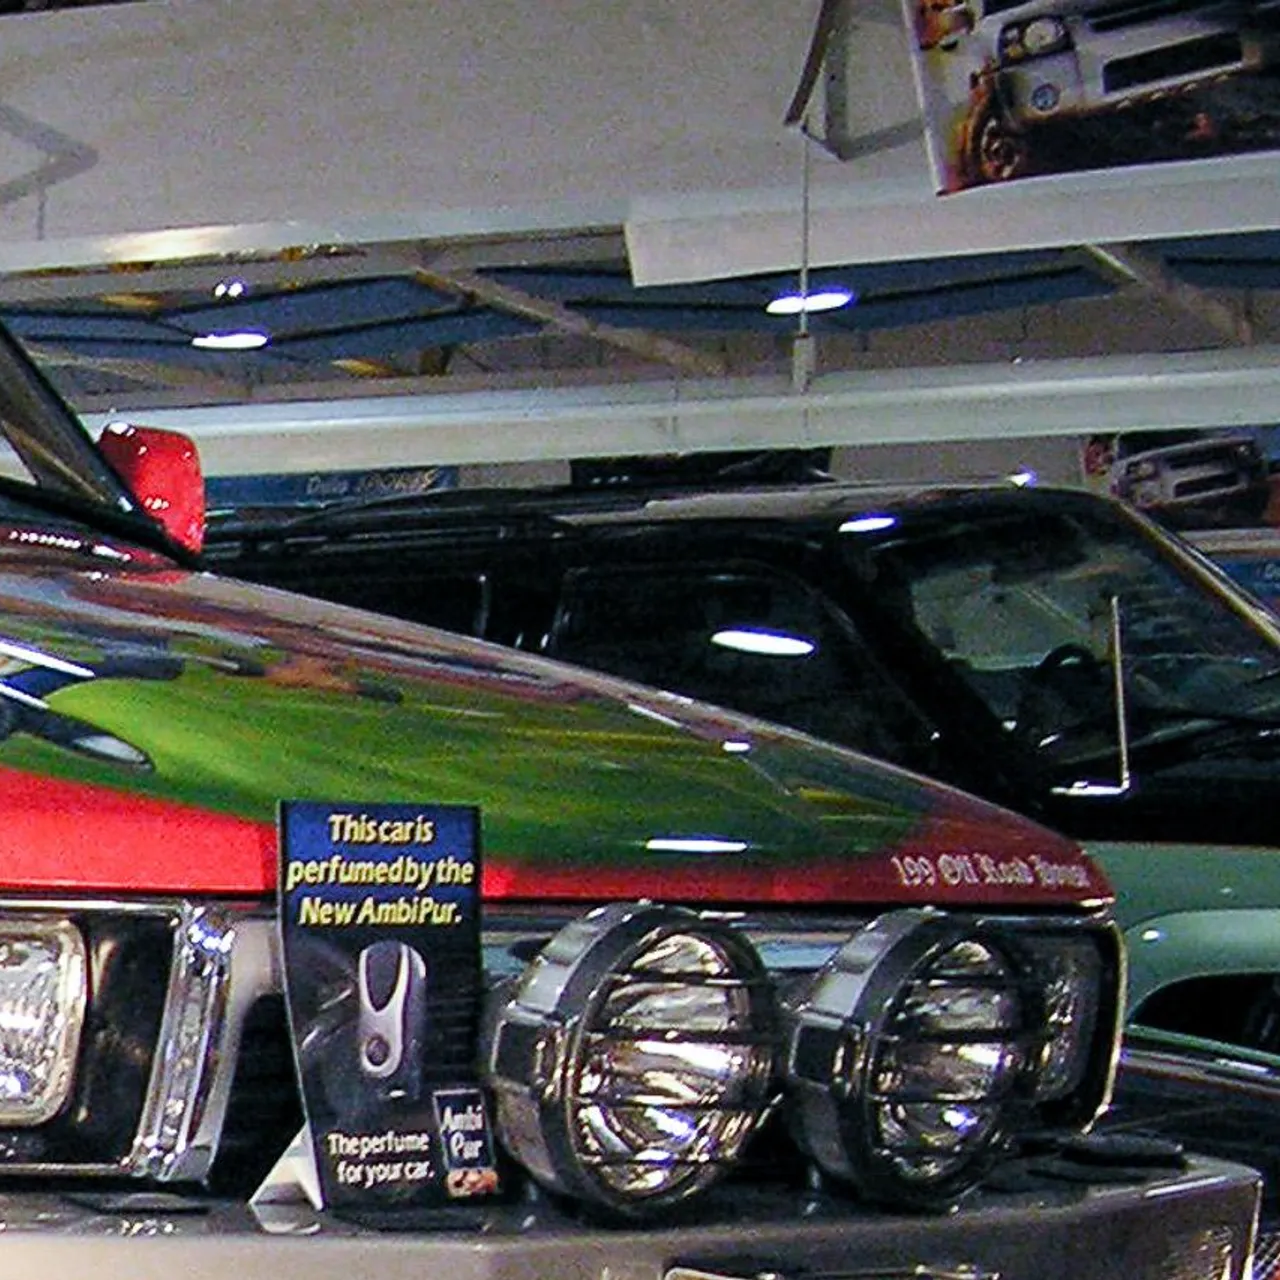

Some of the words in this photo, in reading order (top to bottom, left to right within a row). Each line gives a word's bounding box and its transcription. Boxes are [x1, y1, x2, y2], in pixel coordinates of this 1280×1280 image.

[328, 813, 377, 843] This
[378, 818, 415, 844] car
[414, 814, 434, 843] is
[285, 855, 404, 892] perfumed
[403, 856, 435, 891] by
[436, 855, 475, 884] the
[299, 896, 355, 925] New
[327, 1132, 360, 1155] The
[359, 1131, 430, 1160] perfume
[450, 1131, 484, 1160] Pur
[337, 1161, 363, 1184] for
[364, 1163, 405, 1189] your
[403, 1161, 436, 1181] car.
